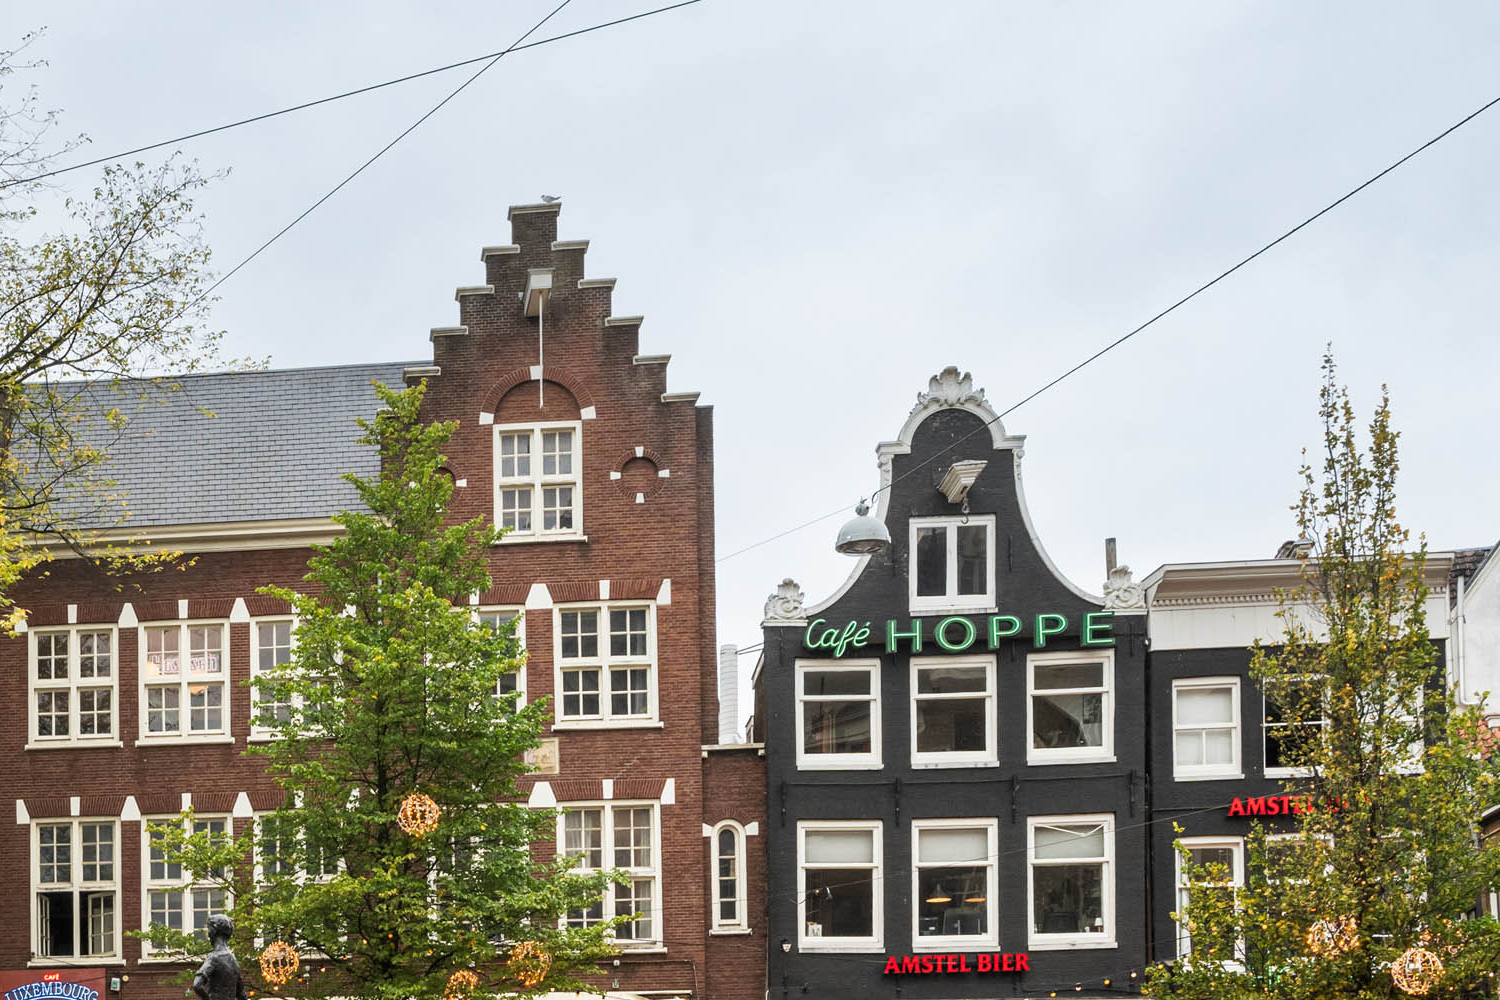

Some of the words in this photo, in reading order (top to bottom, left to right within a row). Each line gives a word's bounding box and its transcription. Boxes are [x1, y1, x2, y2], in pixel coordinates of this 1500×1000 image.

[803, 618, 871, 658] Café
[886, 611, 1115, 654] HOPPE
[884, 954, 971, 974] AMSTEL
[977, 953, 1031, 972] BIER
